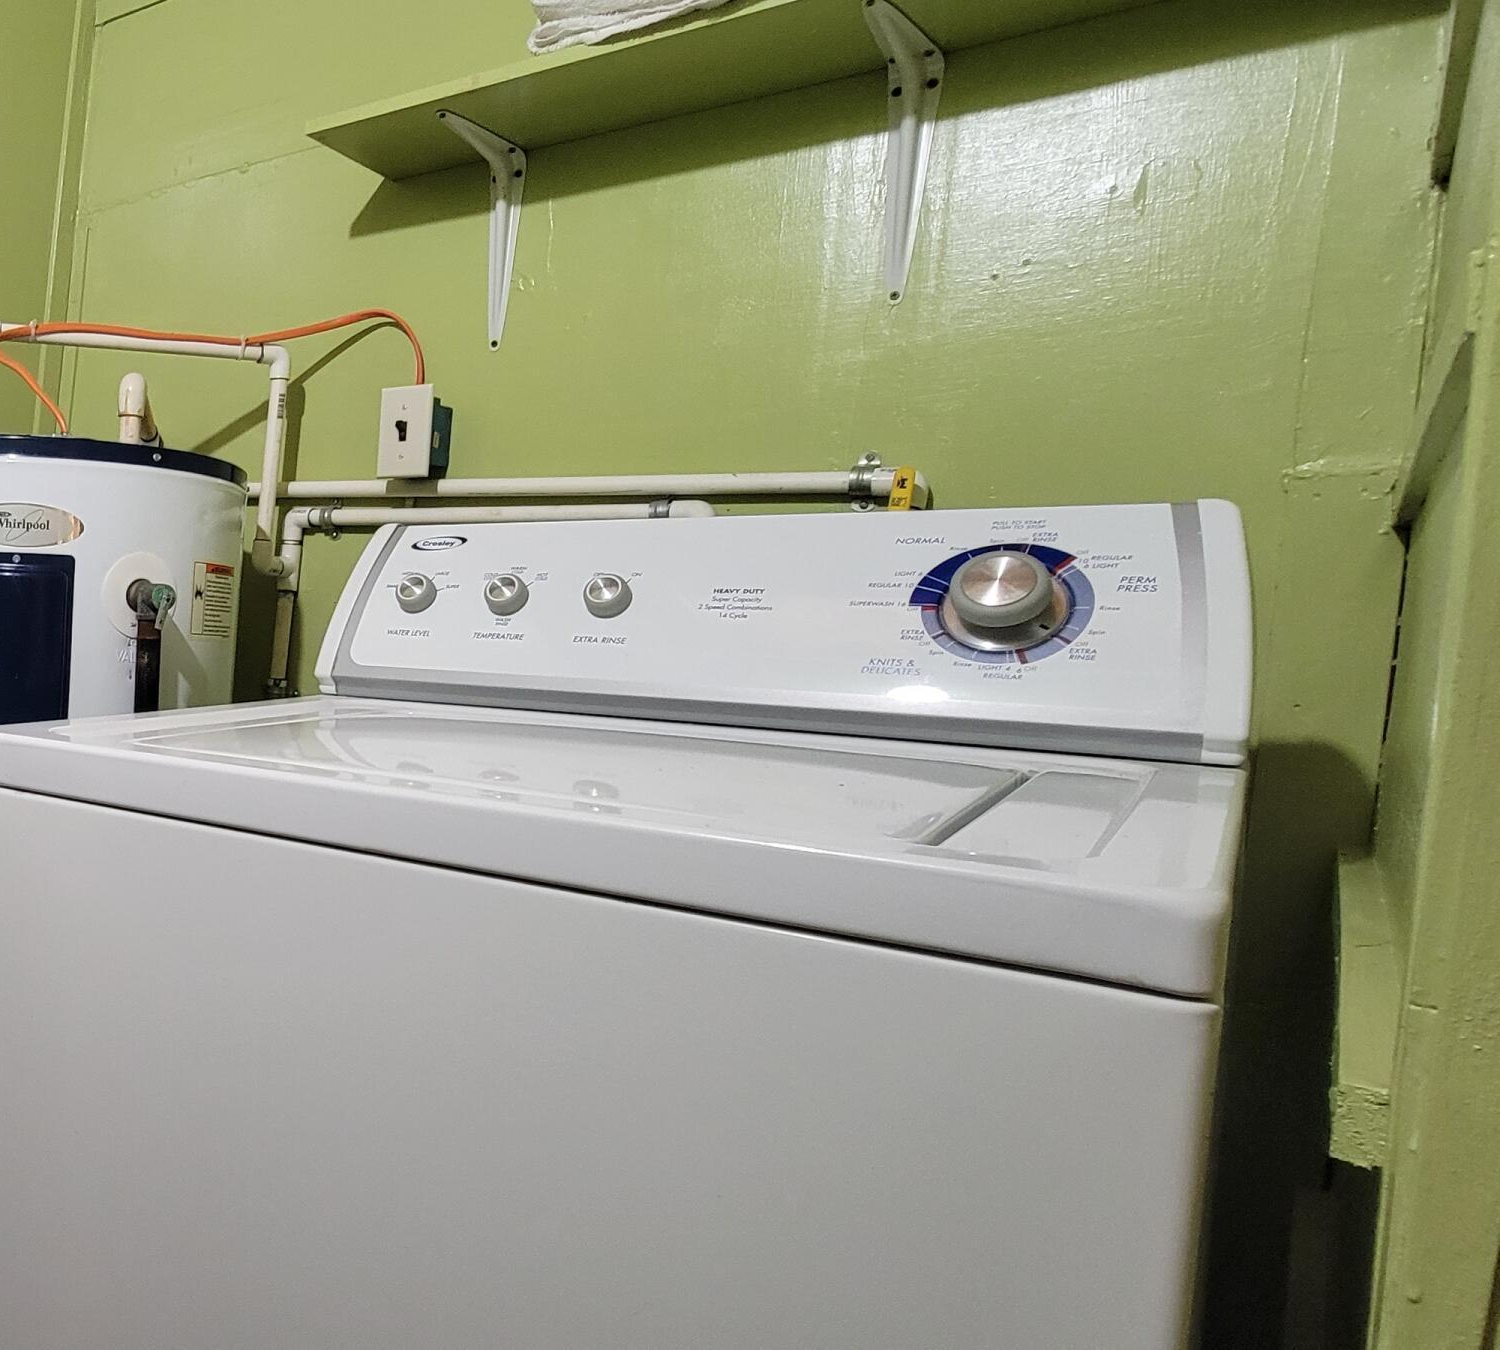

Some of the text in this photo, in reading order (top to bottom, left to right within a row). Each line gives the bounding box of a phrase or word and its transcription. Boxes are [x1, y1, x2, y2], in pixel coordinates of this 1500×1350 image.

[422, 539, 456, 548] Crosley
[895, 537, 946, 545] NORMAL
[1120, 576, 1156, 584] PERM
[1116, 584, 1158, 593] PRESS
[472, 632, 525, 641] TEMPERATURE
[573, 636, 628, 645] EXTRA RINSE
[868, 659, 916, 667] KNITS &
[860, 667, 921, 676] DELICATES
